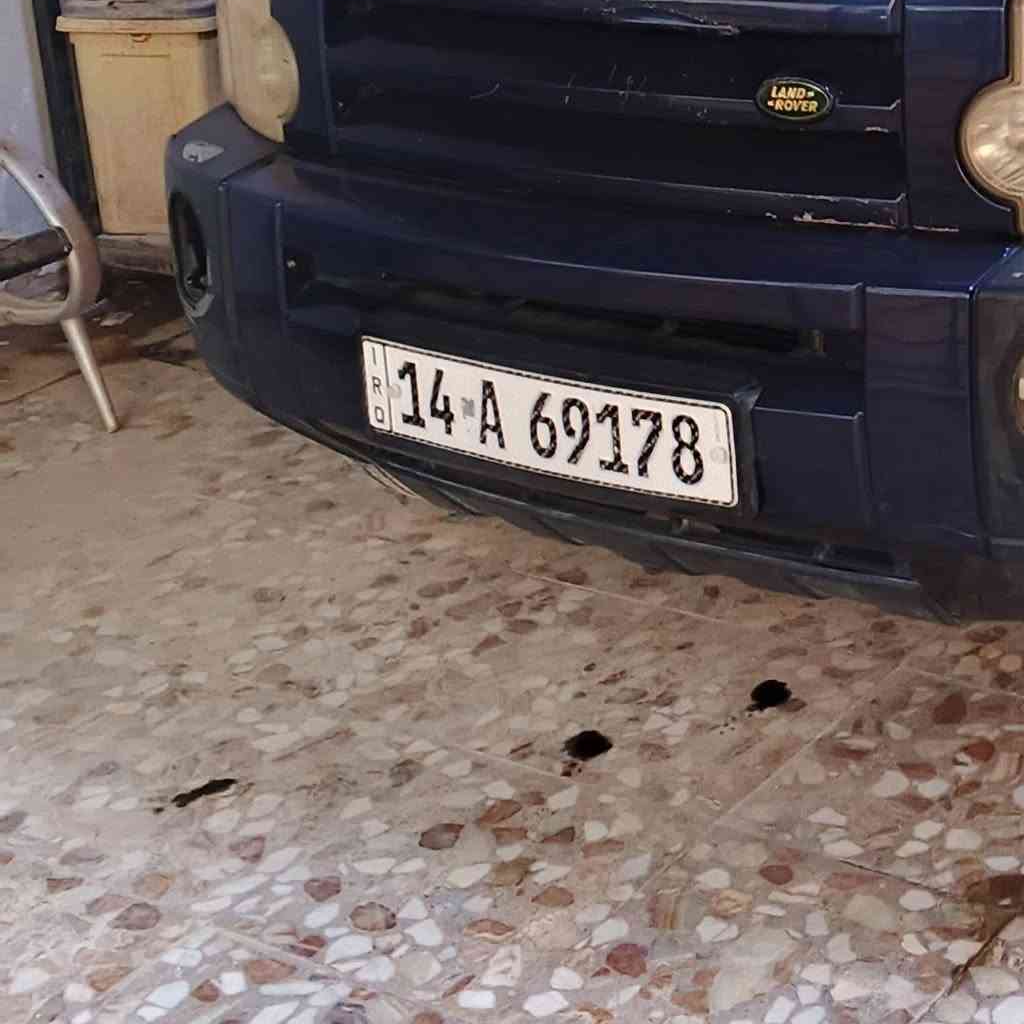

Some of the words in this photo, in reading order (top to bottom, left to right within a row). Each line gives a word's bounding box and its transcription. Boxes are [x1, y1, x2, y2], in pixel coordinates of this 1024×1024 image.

[770, 86, 807, 99] LAND
[774, 99, 818, 113] ROVER
[398, 360, 455, 436] 14
[480, 379, 506, 450] A
[529, 391, 704, 486] 69178
